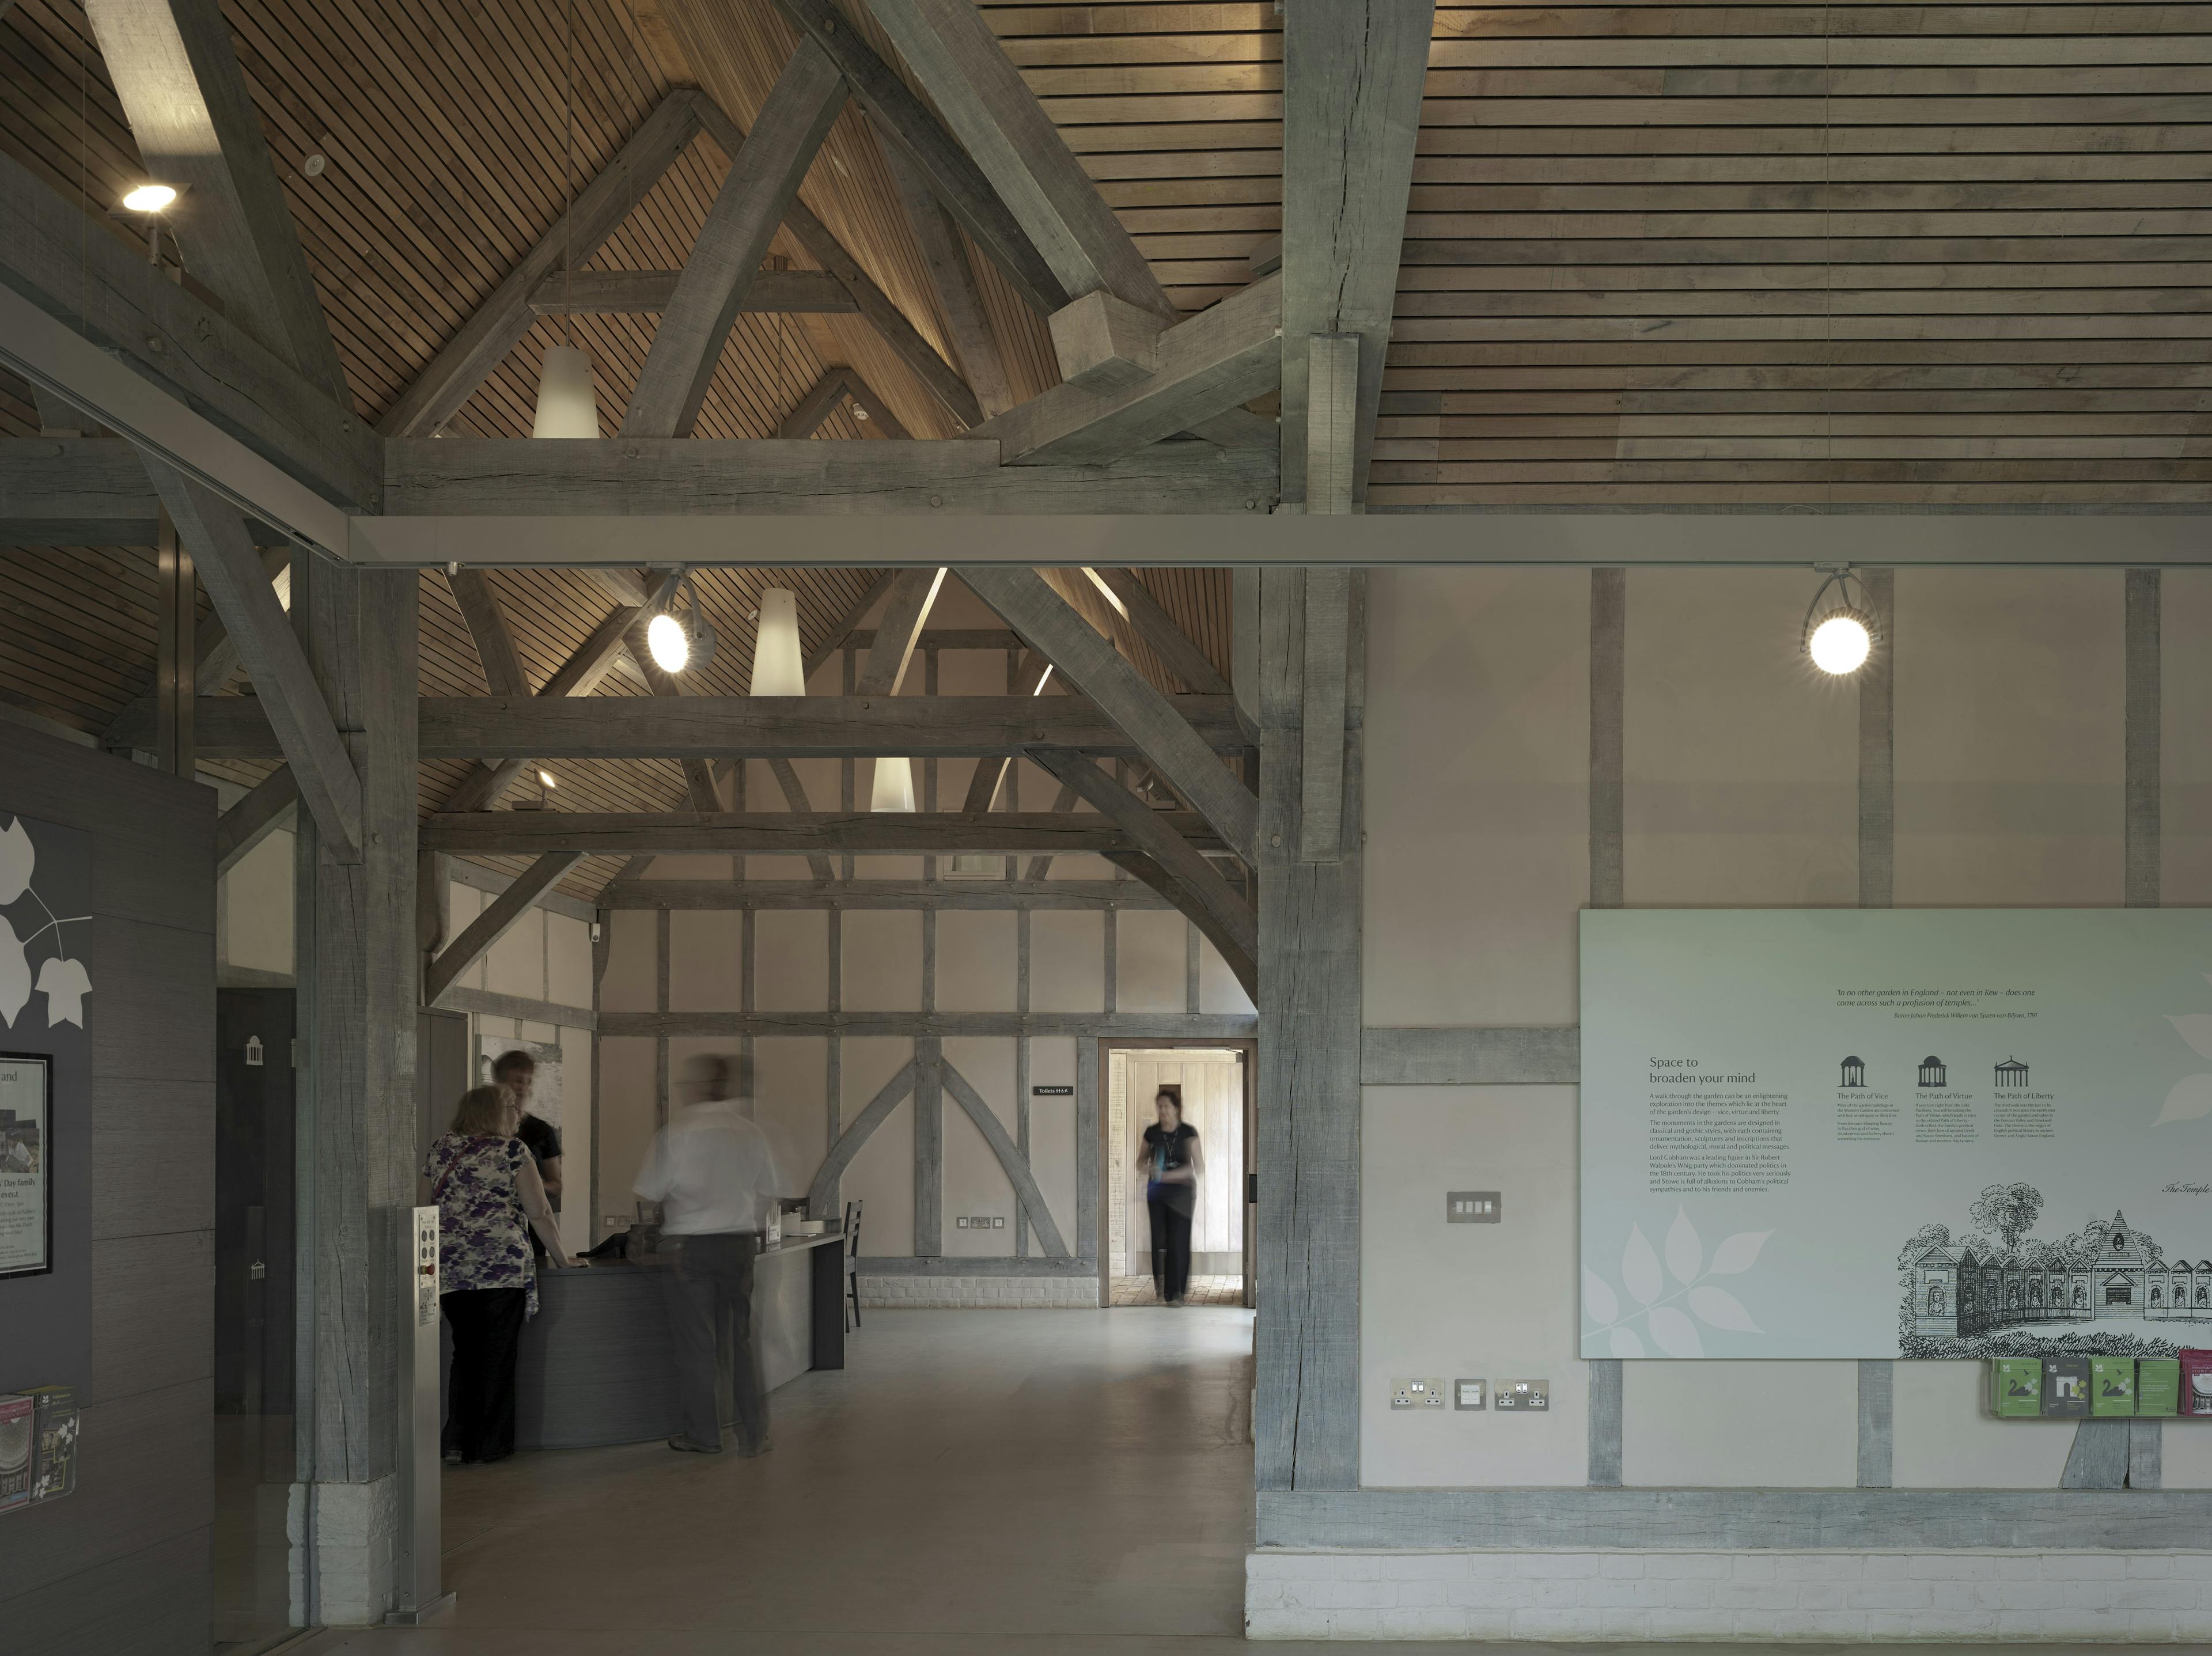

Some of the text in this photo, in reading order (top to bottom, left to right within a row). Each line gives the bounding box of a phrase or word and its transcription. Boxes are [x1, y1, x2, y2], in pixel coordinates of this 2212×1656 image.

[1877, 989, 1900, 997] garden
[1910, 989, 1939, 997] England
[1902, 999, 1934, 1007] profusion
[1936, 999, 1944, 1007] of
[1945, 999, 1979, 1007] temples...'
[1650, 1057, 1698, 1070] Space to
[1, 1071, 17, 1081] and
[1650, 1072, 1755, 1085] broaden your mind
[4, 1179, 16, 1188] Day
[18, 1178, 36, 1187] family
[2162, 1182, 2210, 1196] The Temple
